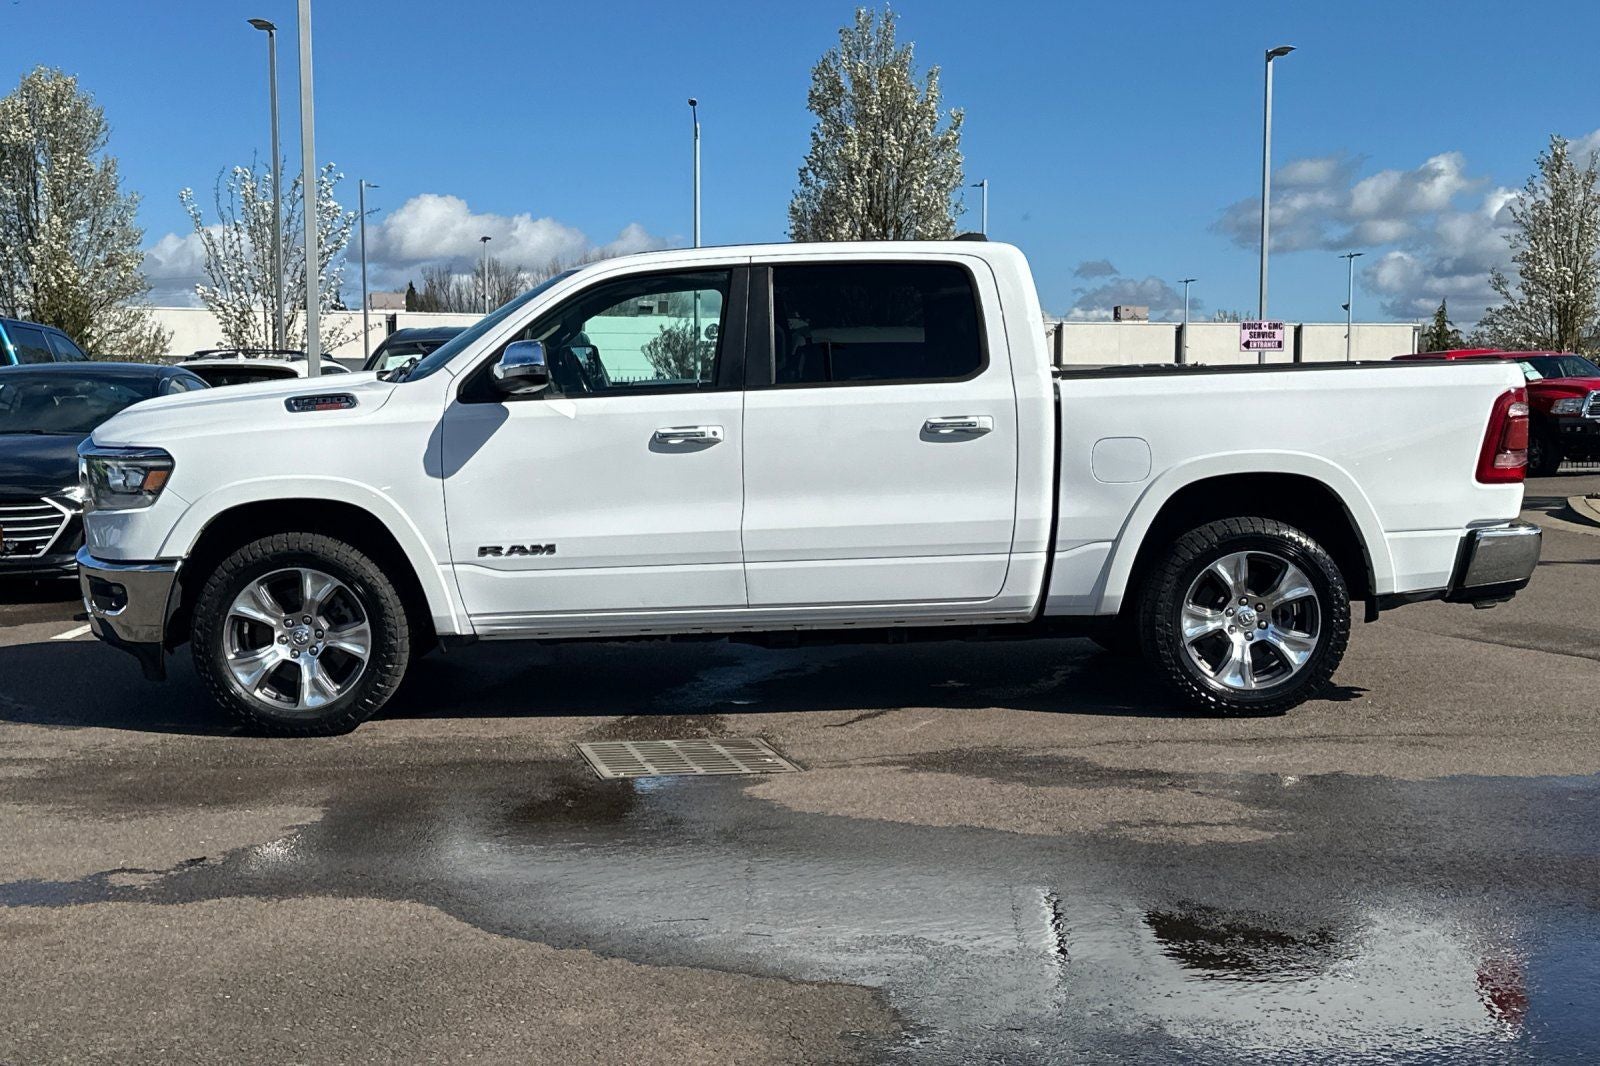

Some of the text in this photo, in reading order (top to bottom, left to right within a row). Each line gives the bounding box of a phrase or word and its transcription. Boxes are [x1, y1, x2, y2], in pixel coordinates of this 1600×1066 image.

[1242, 322, 1283, 330] BUICK GMC
[1249, 331, 1276, 339] SERVICE
[477, 543, 556, 557] RAM
